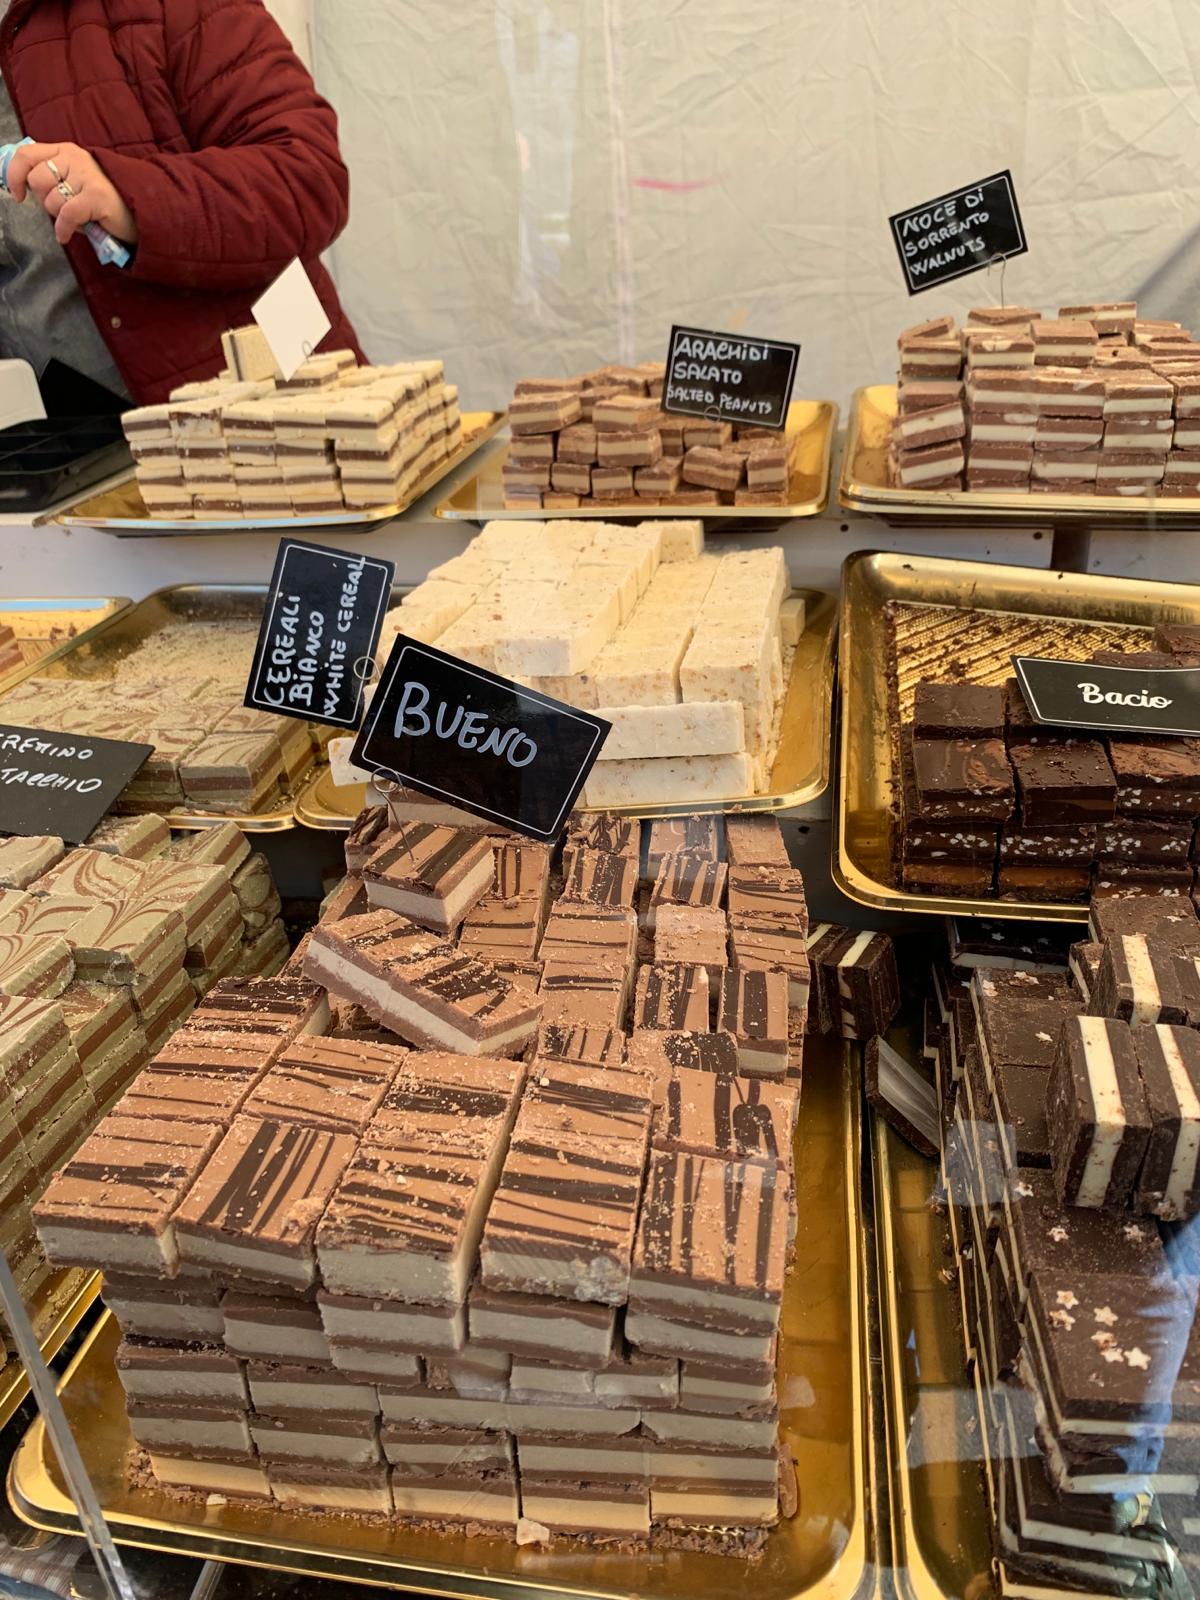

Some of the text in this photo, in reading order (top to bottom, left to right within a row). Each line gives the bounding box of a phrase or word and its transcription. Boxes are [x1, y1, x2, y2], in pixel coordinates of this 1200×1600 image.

[903, 200, 956, 237] NOCE
[905, 212, 989, 257] SORRENTO
[910, 237, 985, 275] WALNUTS
[674, 361, 742, 384] SALATO
[667, 384, 772, 414] SALTED PEANUTS
[338, 556, 366, 632] CEREAL
[1077, 683, 1172, 709] Bacio
[394, 681, 538, 767] BUENO
[0, 733, 94, 760] REMINO
